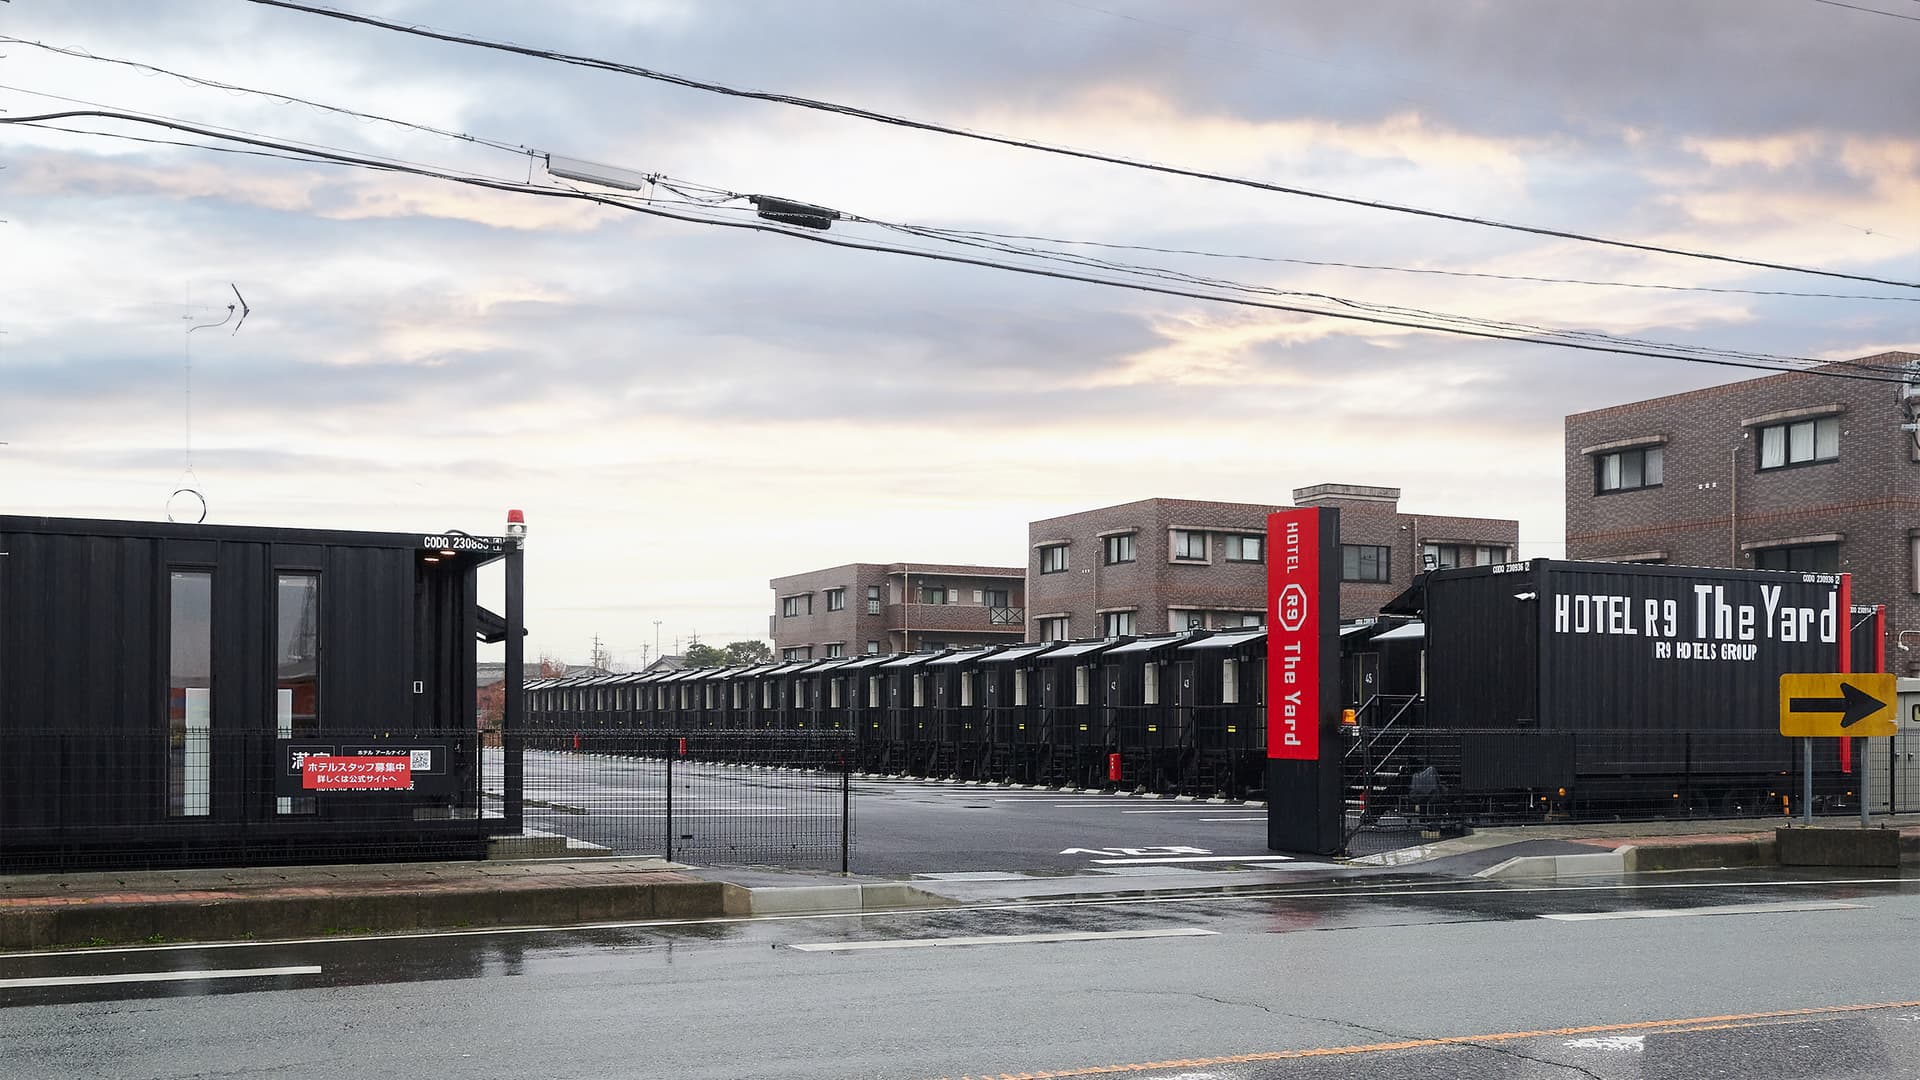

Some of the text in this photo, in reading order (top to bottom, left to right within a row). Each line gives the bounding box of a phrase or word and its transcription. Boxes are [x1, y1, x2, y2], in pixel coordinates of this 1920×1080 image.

[1555, 584, 1837, 643] HOTEL R9 The Yard
[1284, 521, 1302, 746] HOTEL R9 The Yard
[1655, 641, 1758, 661] R9 HOTELS GROUP
[1365, 672, 1373, 684] 45
[308, 763, 406, 773] ホテルスタッフ募集中
[317, 775, 397, 783] 詳しくは公式サイトへ
